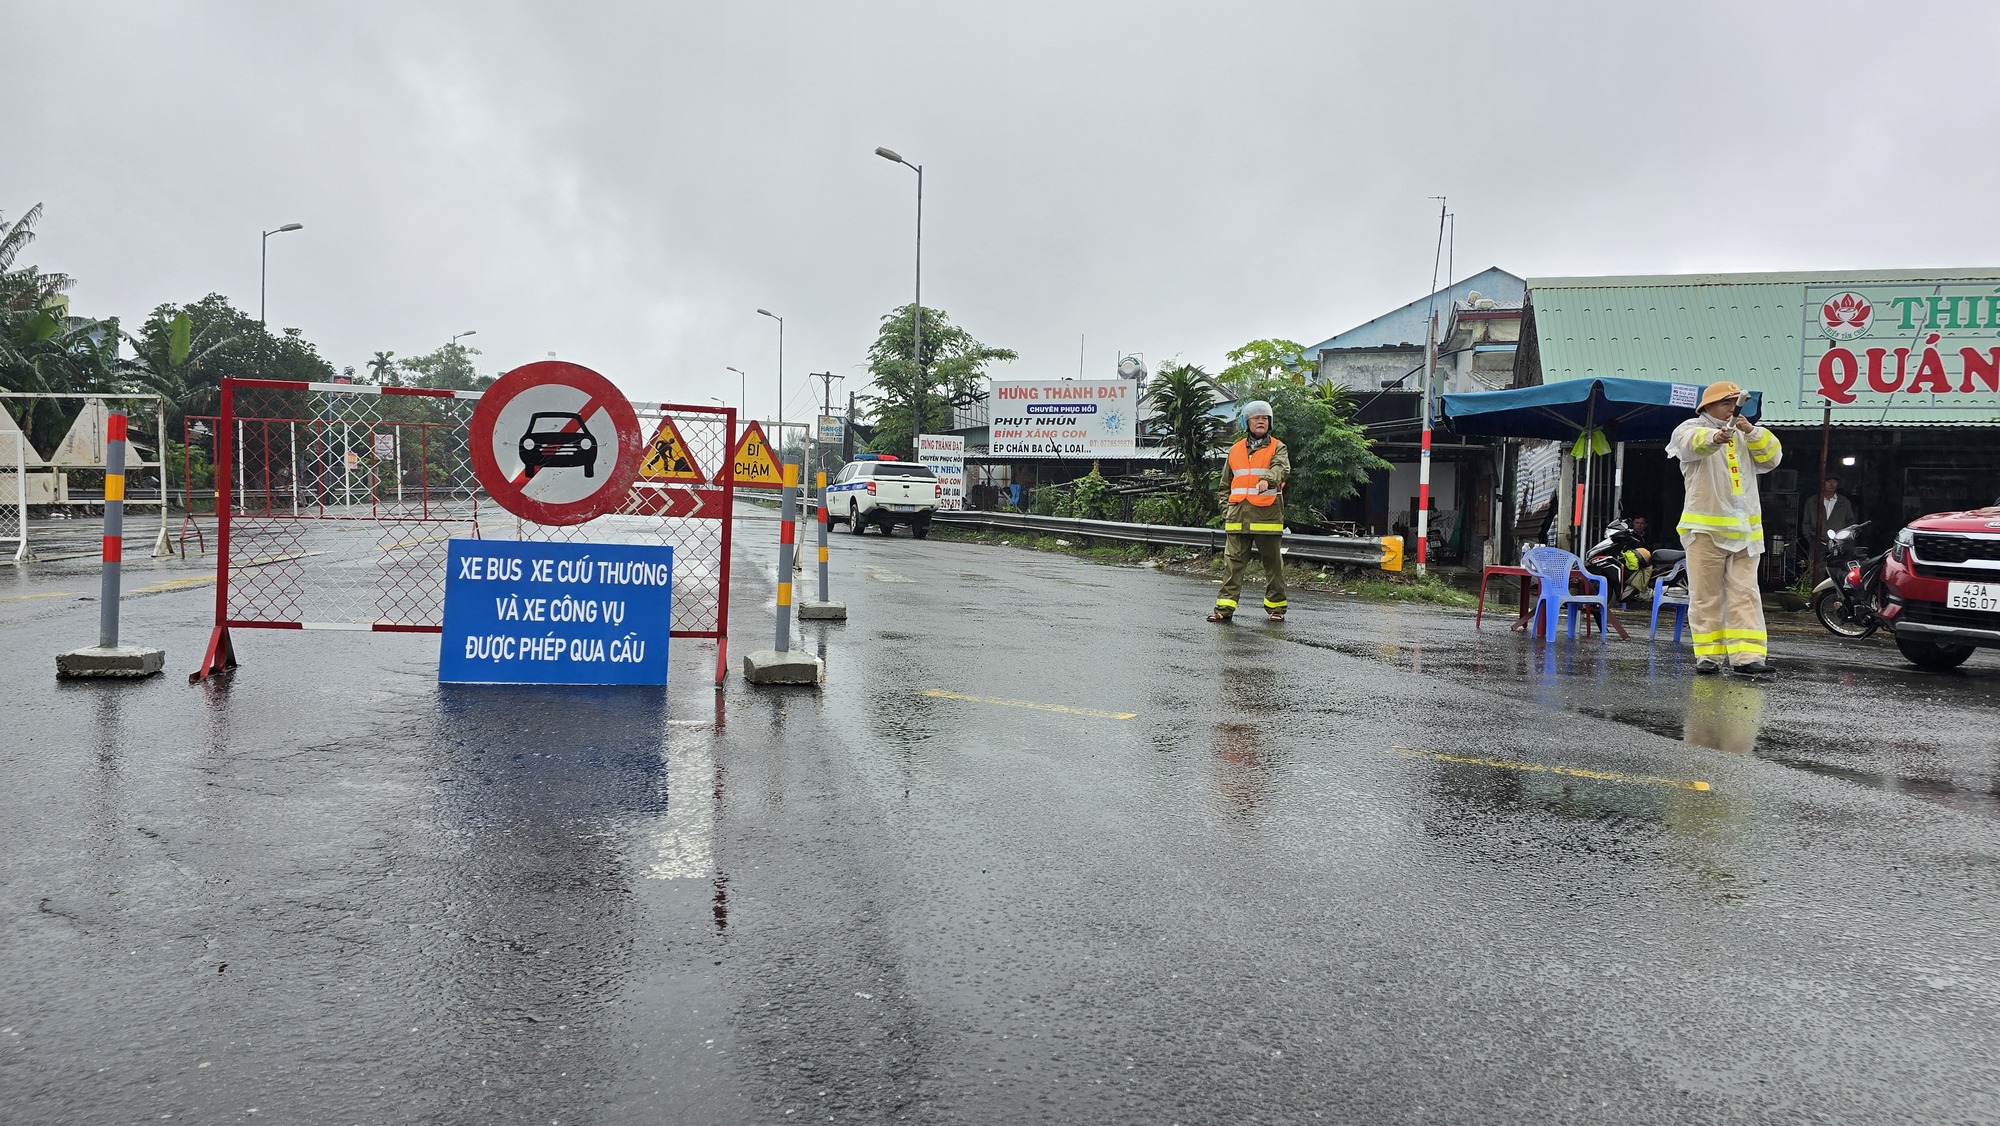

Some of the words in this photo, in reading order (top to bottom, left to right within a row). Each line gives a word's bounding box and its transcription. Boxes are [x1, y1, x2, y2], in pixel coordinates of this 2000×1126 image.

[998, 385, 1039, 400] HƯNG
[1043, 384, 1093, 399] THÀNH
[1097, 386, 1127, 402] ĐẠT
[1029, 405, 1059, 413] CHUYÊN
[1060, 406, 1080, 414] PHỤC
[994, 417, 1032, 428] PHỤT
[1036, 415, 1077, 426] NHÚN
[994, 428, 1023, 438] BÌNH
[1026, 428, 1058, 438] XĂNG
[1061, 430, 1087, 438] CON
[747, 443, 760, 457] ĐI
[993, 441, 1004, 453] ÉP
[1006, 440, 1030, 453] CHẤN
[1032, 444, 1043, 453] BA
[1045, 441, 1063, 453] CÁC
[734, 461, 770, 479] CHẬM
[940, 464, 962, 474] NHÚN
[949, 477, 961, 485] CON
[458, 556, 483, 580] XE
[486, 557, 523, 581] BUS
[530, 559, 554, 583] XE
[597, 560, 668, 586] THƯƠNG
[1963, 584, 1988, 597] 43A
[496, 593, 519, 621] VÀ
[522, 598, 546, 622] XE
[549, 594, 597, 623] CÔNG
[602, 601, 625, 626] VỤ
[1953, 596, 1998, 610] 596.07
[465, 634, 516, 663] ĐƯỢC
[518, 631, 566, 661] PHÉP
[570, 639, 606, 662] QUA
